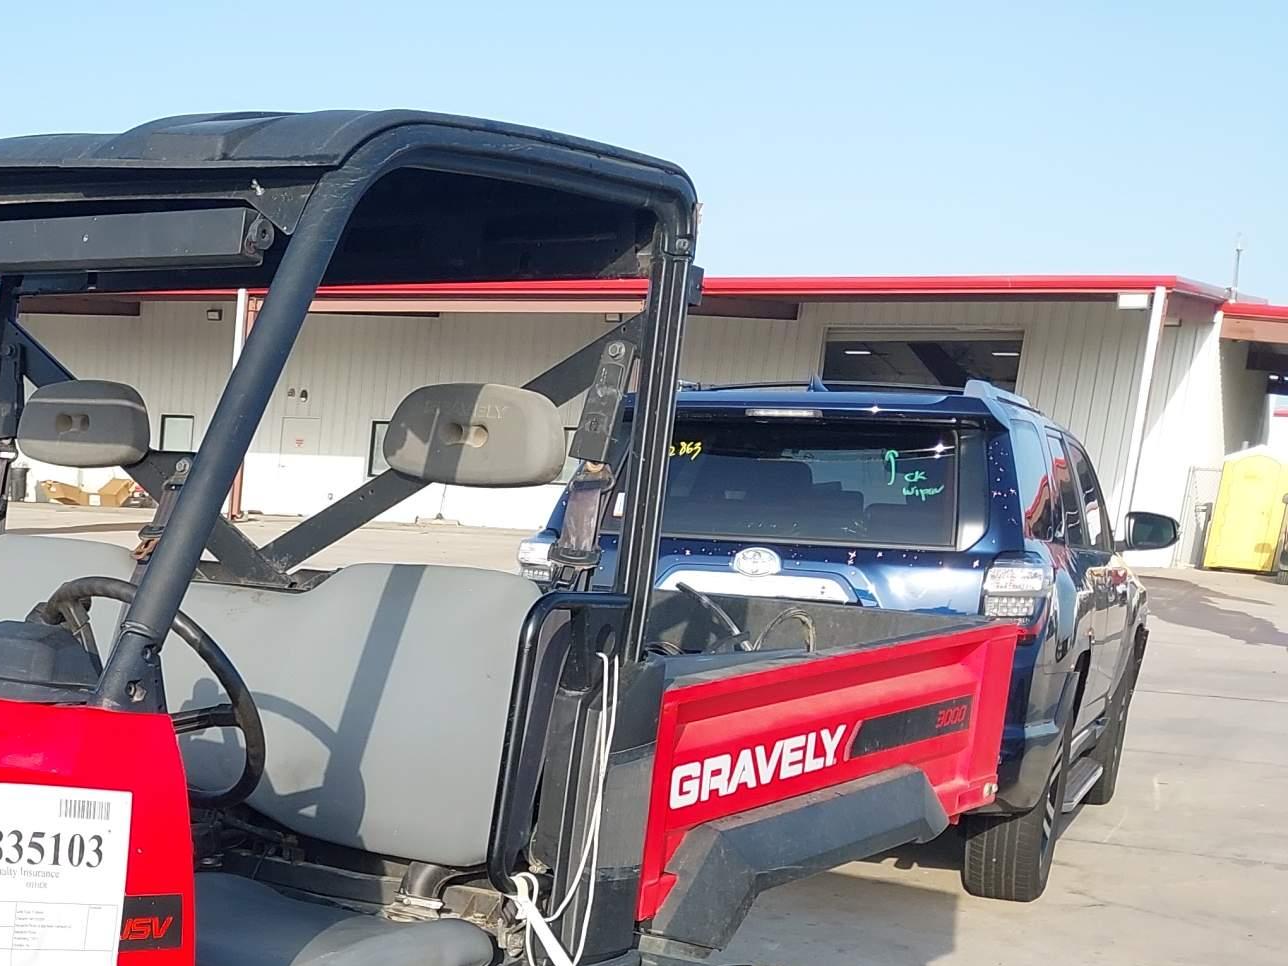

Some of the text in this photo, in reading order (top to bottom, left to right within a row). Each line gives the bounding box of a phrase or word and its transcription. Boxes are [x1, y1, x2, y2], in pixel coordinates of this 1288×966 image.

[935, 704, 968, 729] 3000
[669, 724, 847, 810] GRAVELY
[20, 867, 60, 879] Insurance
